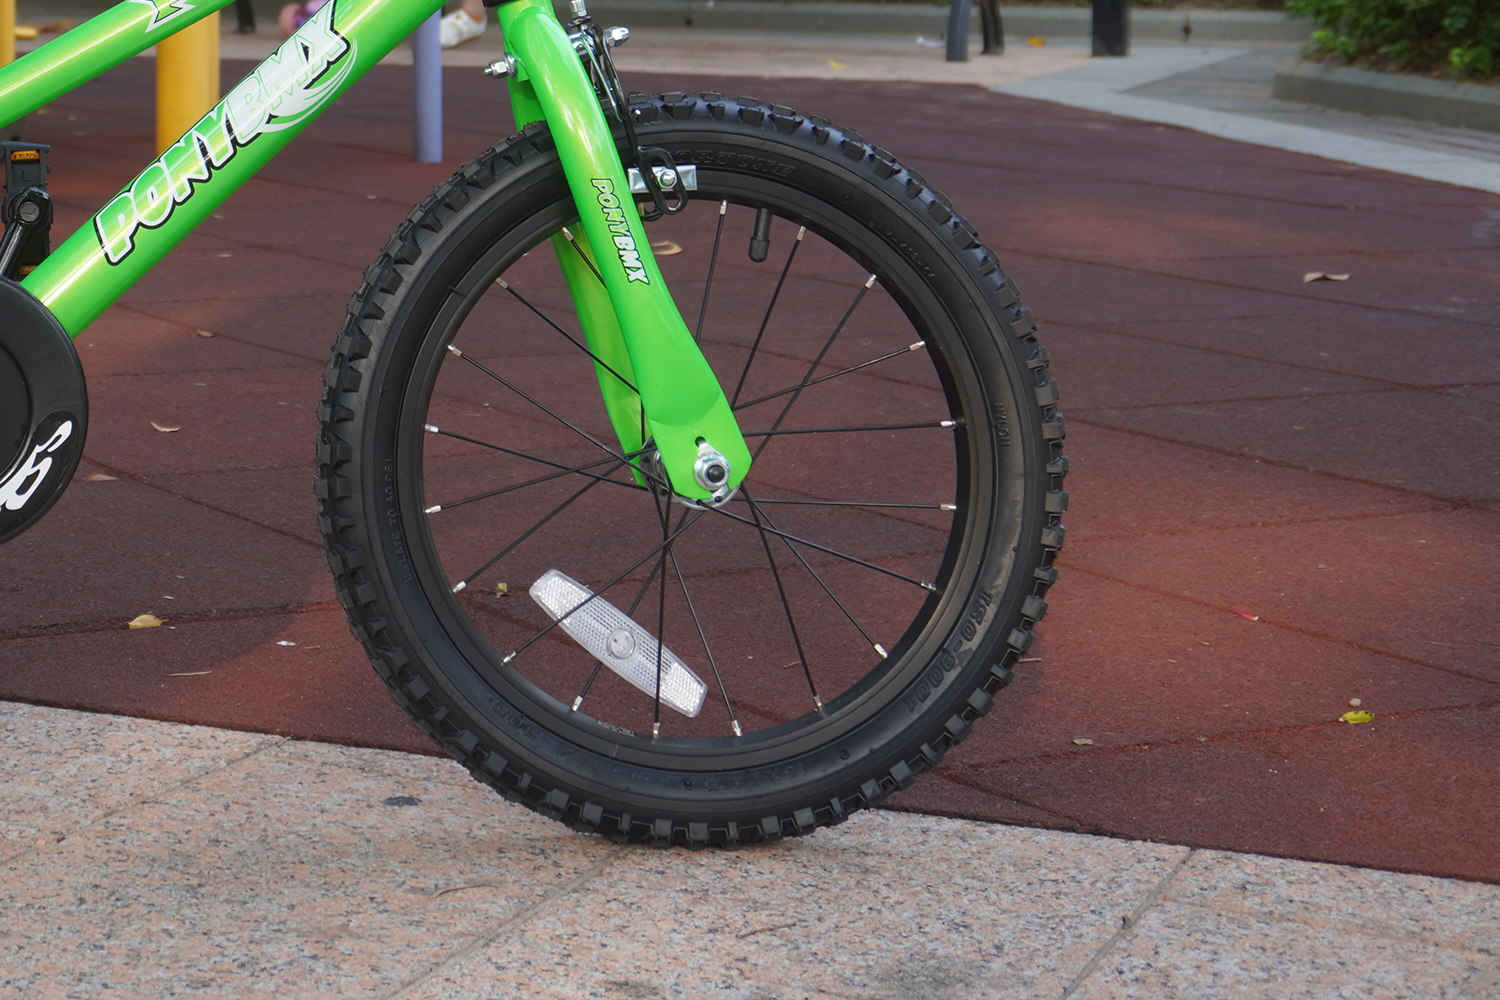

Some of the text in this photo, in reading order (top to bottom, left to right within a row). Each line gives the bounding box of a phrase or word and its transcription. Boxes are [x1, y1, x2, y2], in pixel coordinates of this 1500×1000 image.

[676, 149, 795, 180] ORTUNE
[591, 179, 650, 285] PONYBMX
[993, 401, 1011, 447] NYLON
[904, 588, 994, 714] ISO-9001
